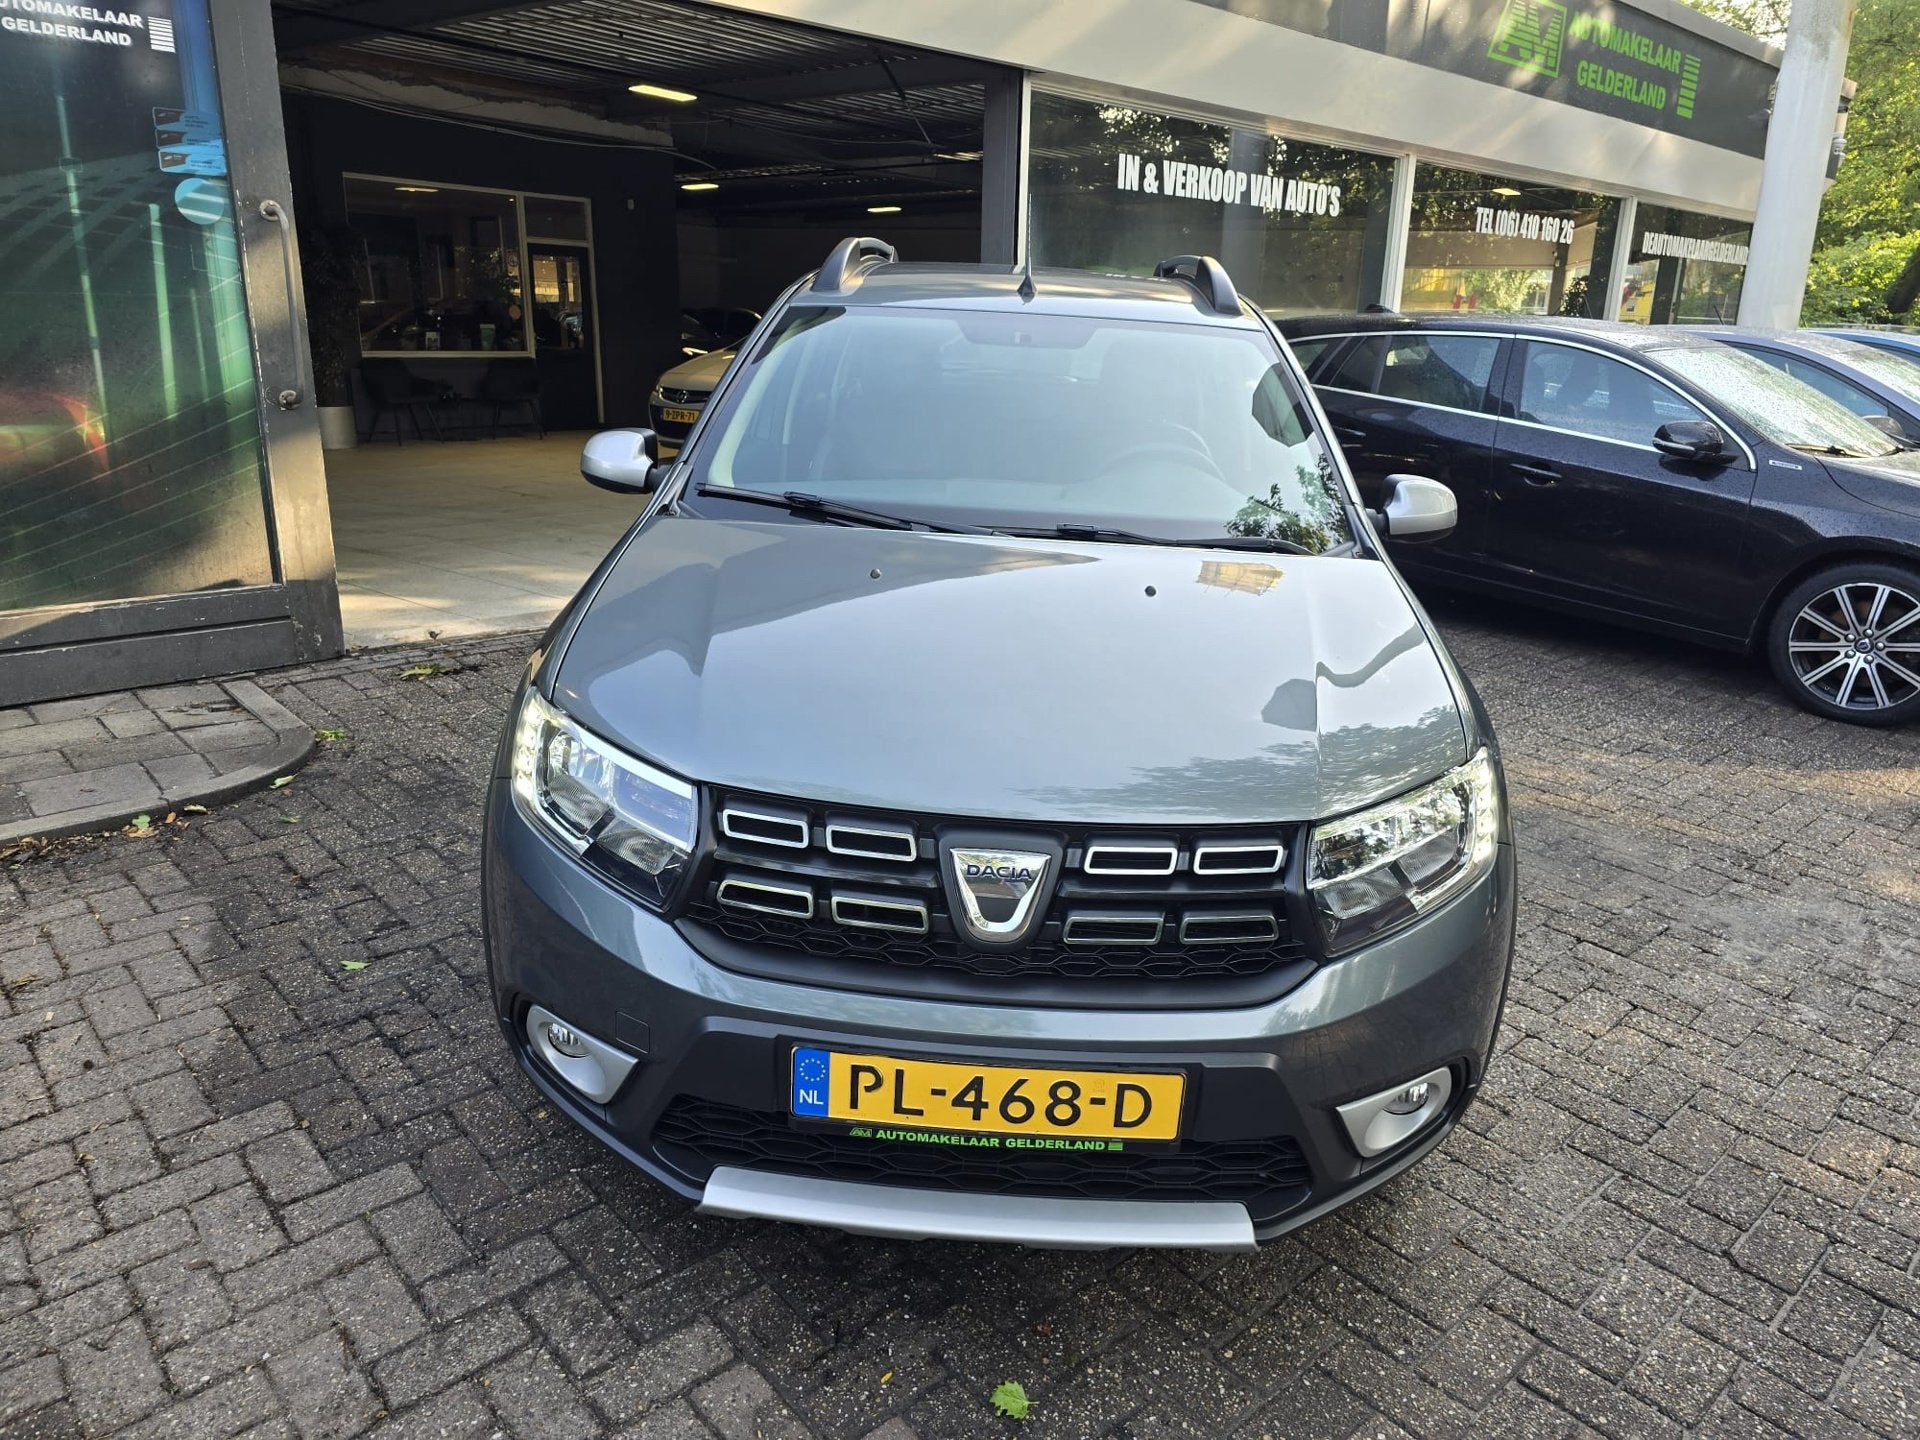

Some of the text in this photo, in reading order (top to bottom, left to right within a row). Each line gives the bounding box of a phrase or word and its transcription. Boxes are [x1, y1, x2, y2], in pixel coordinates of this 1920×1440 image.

[1, 16, 132, 46] GELDERLAND
[1568, 12, 1681, 74] AUTOMAKELAAR
[1577, 60, 1667, 110] GELDERLAND
[1117, 153, 1341, 217] IN & VERKOOP VAN AUTO'S
[1476, 206, 1575, 244] TEL (06) 410 160 26
[966, 864, 1032, 880] DACIA
[799, 1089, 824, 1105] NL
[849, 1064, 1152, 1128] PL-468-D
[876, 1129, 999, 1147] AUTOMAKELAAR
[1005, 1138, 1105, 1151] GELDERLAND
